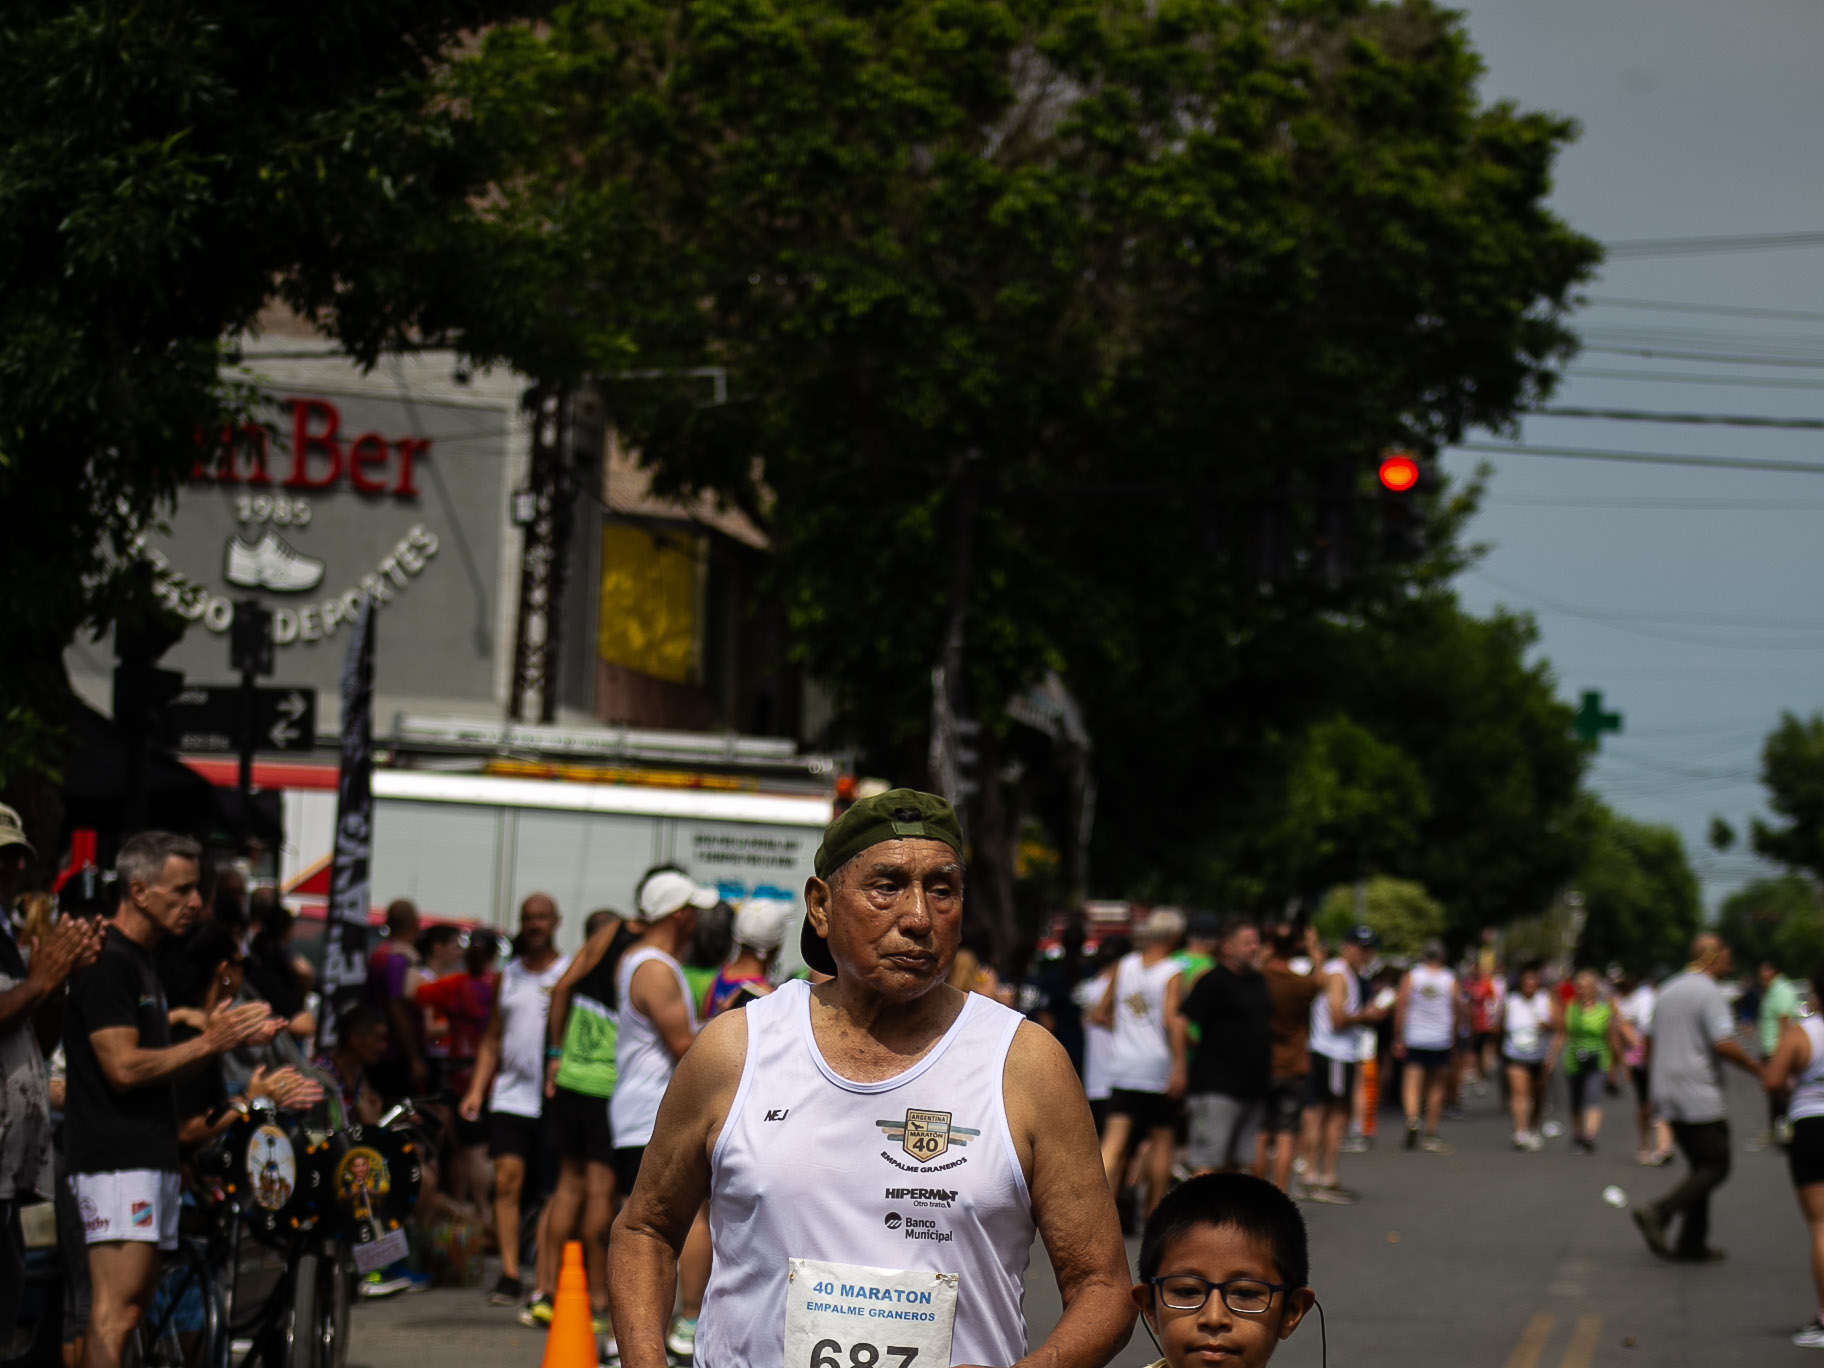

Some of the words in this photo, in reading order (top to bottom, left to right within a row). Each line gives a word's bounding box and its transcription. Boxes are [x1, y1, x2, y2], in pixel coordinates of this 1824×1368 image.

[271, 524, 440, 645] DEPORTES
[763, 1109, 789, 1122] NEJ
[911, 1113, 946, 1122] ARGENTINA
[912, 1138, 939, 1153] 40
[880, 1151, 919, 1173] EMPALME
[920, 1156, 968, 1173] GRANEROS
[913, 1200, 929, 1208] Otro
[905, 1217, 936, 1229] Banco
[905, 1228, 953, 1243] Municipal
[813, 1281, 834, 1296] 40
[840, 1283, 932, 1305] MARATON
[806, 1301, 865, 1316] EMPALME
[868, 1308, 936, 1322] GRANEROS
